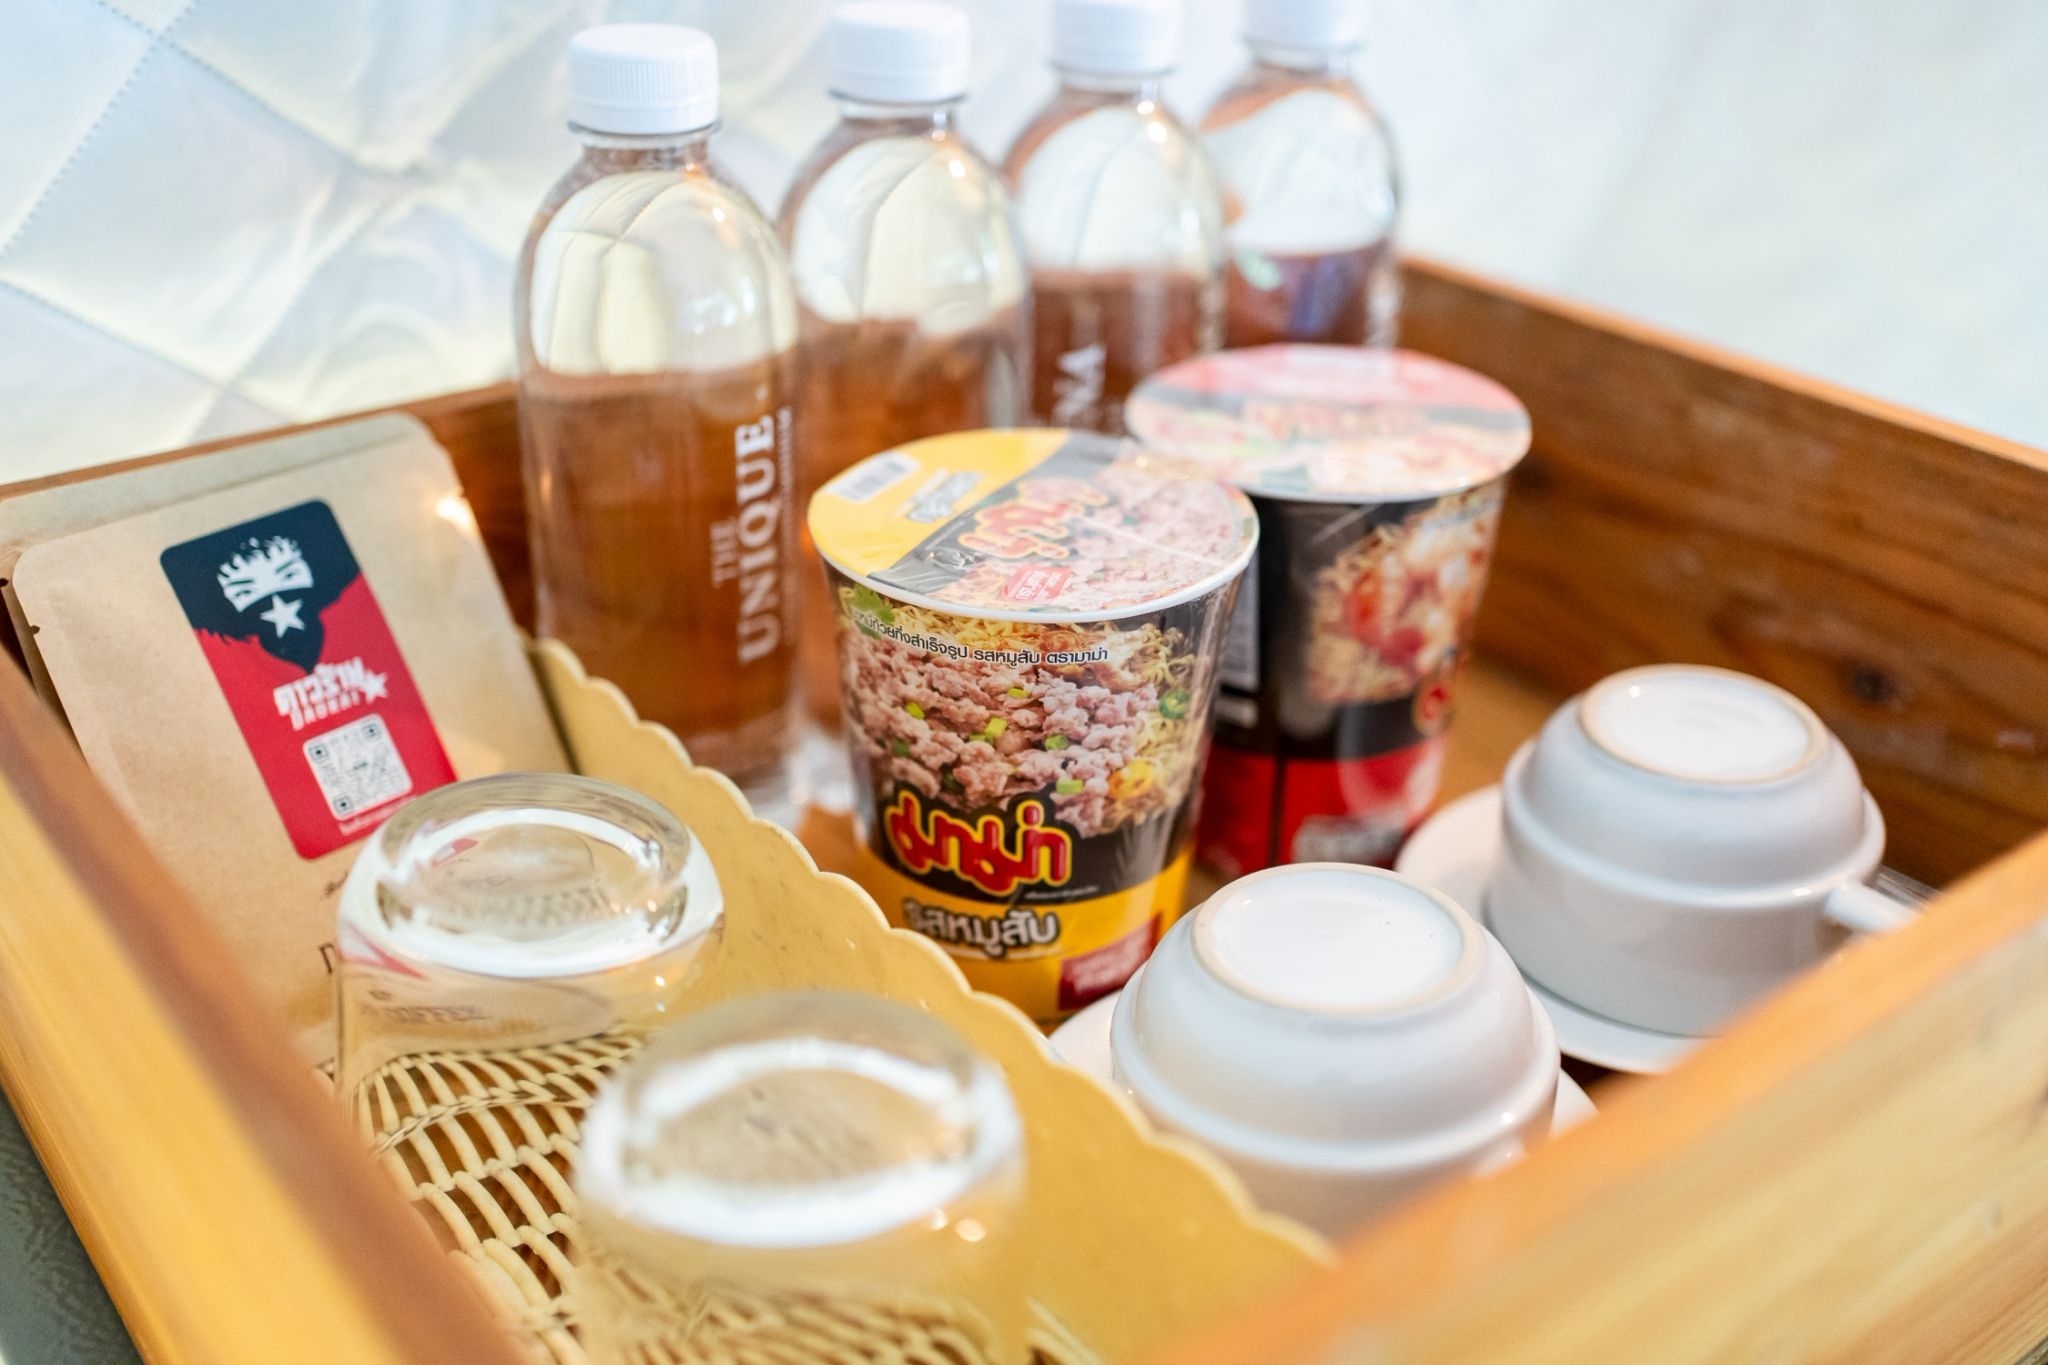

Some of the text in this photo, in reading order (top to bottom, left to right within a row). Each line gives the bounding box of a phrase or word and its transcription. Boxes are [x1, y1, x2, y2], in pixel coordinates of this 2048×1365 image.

[711, 516, 738, 588] THE
[973, 649, 1041, 667] รสหมูสับ
[1045, 646, 1109, 664] ตรามาม่า
[885, 791, 1072, 895] มาม่า
